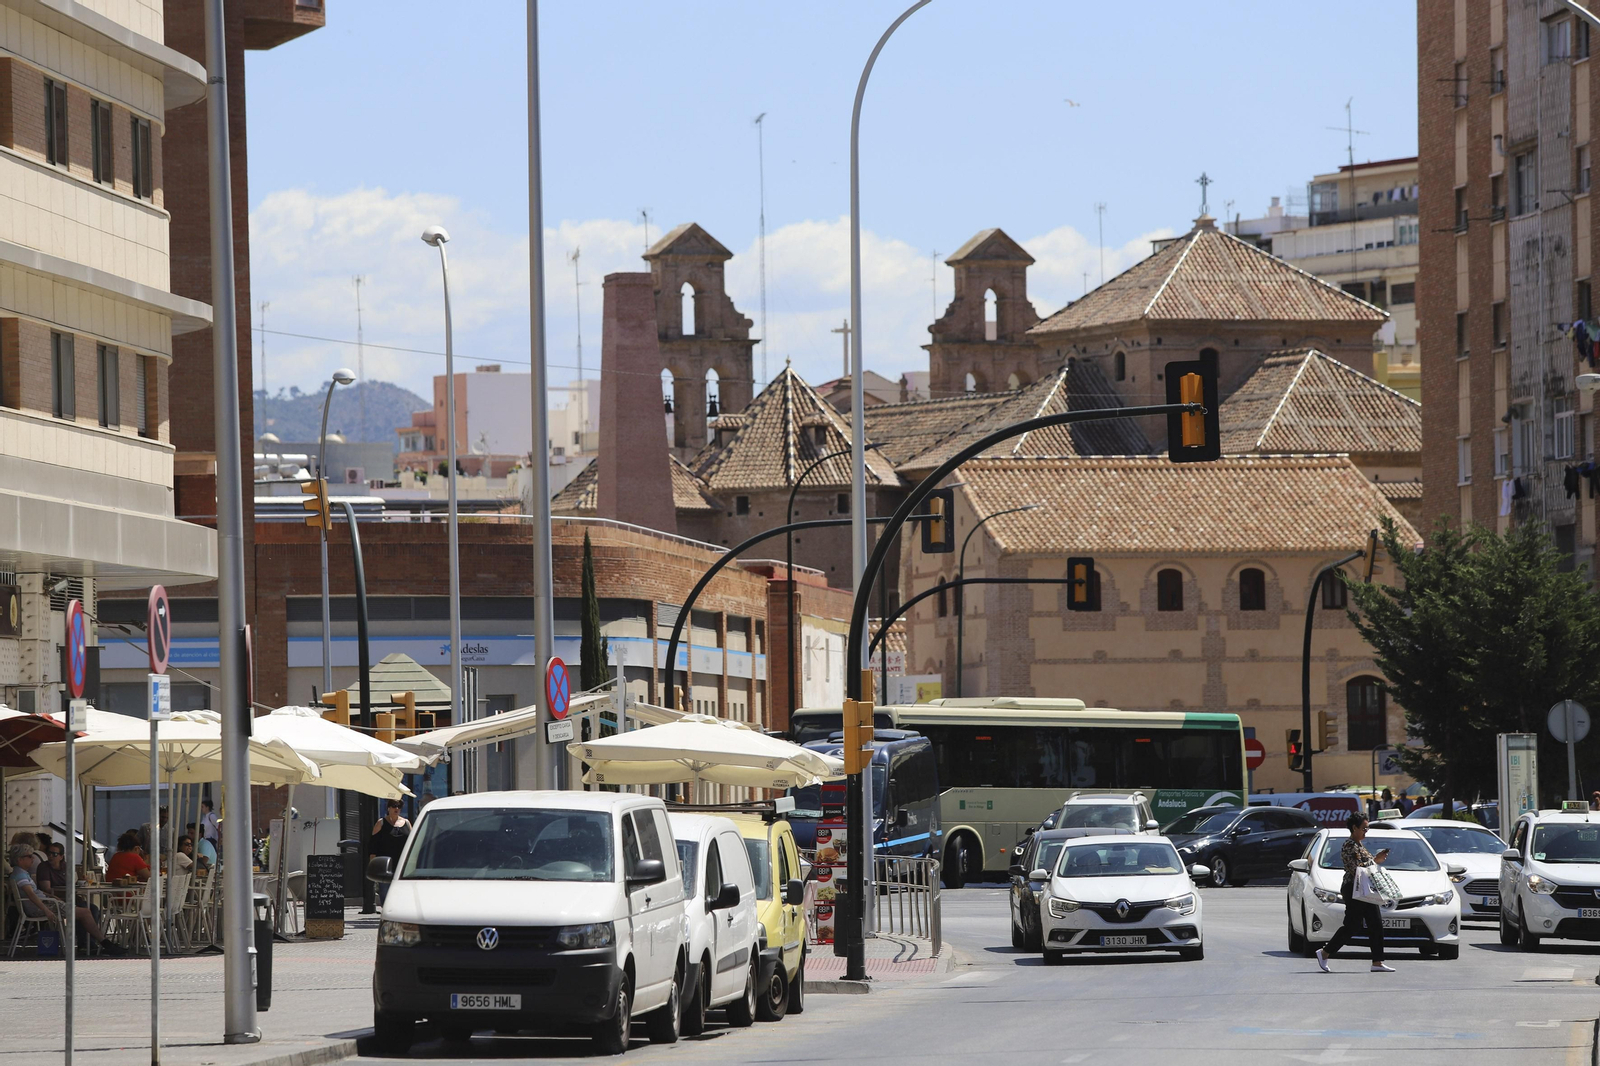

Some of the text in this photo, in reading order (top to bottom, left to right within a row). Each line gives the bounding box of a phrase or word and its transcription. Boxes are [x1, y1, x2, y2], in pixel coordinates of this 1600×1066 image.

[461, 643, 489, 654] deslas
[1157, 799, 1187, 808] Andalucía
[1391, 919, 1407, 928] HTT
[1105, 936, 1145, 946] 3130 JHK
[461, 995, 516, 1008] 9656 HML
